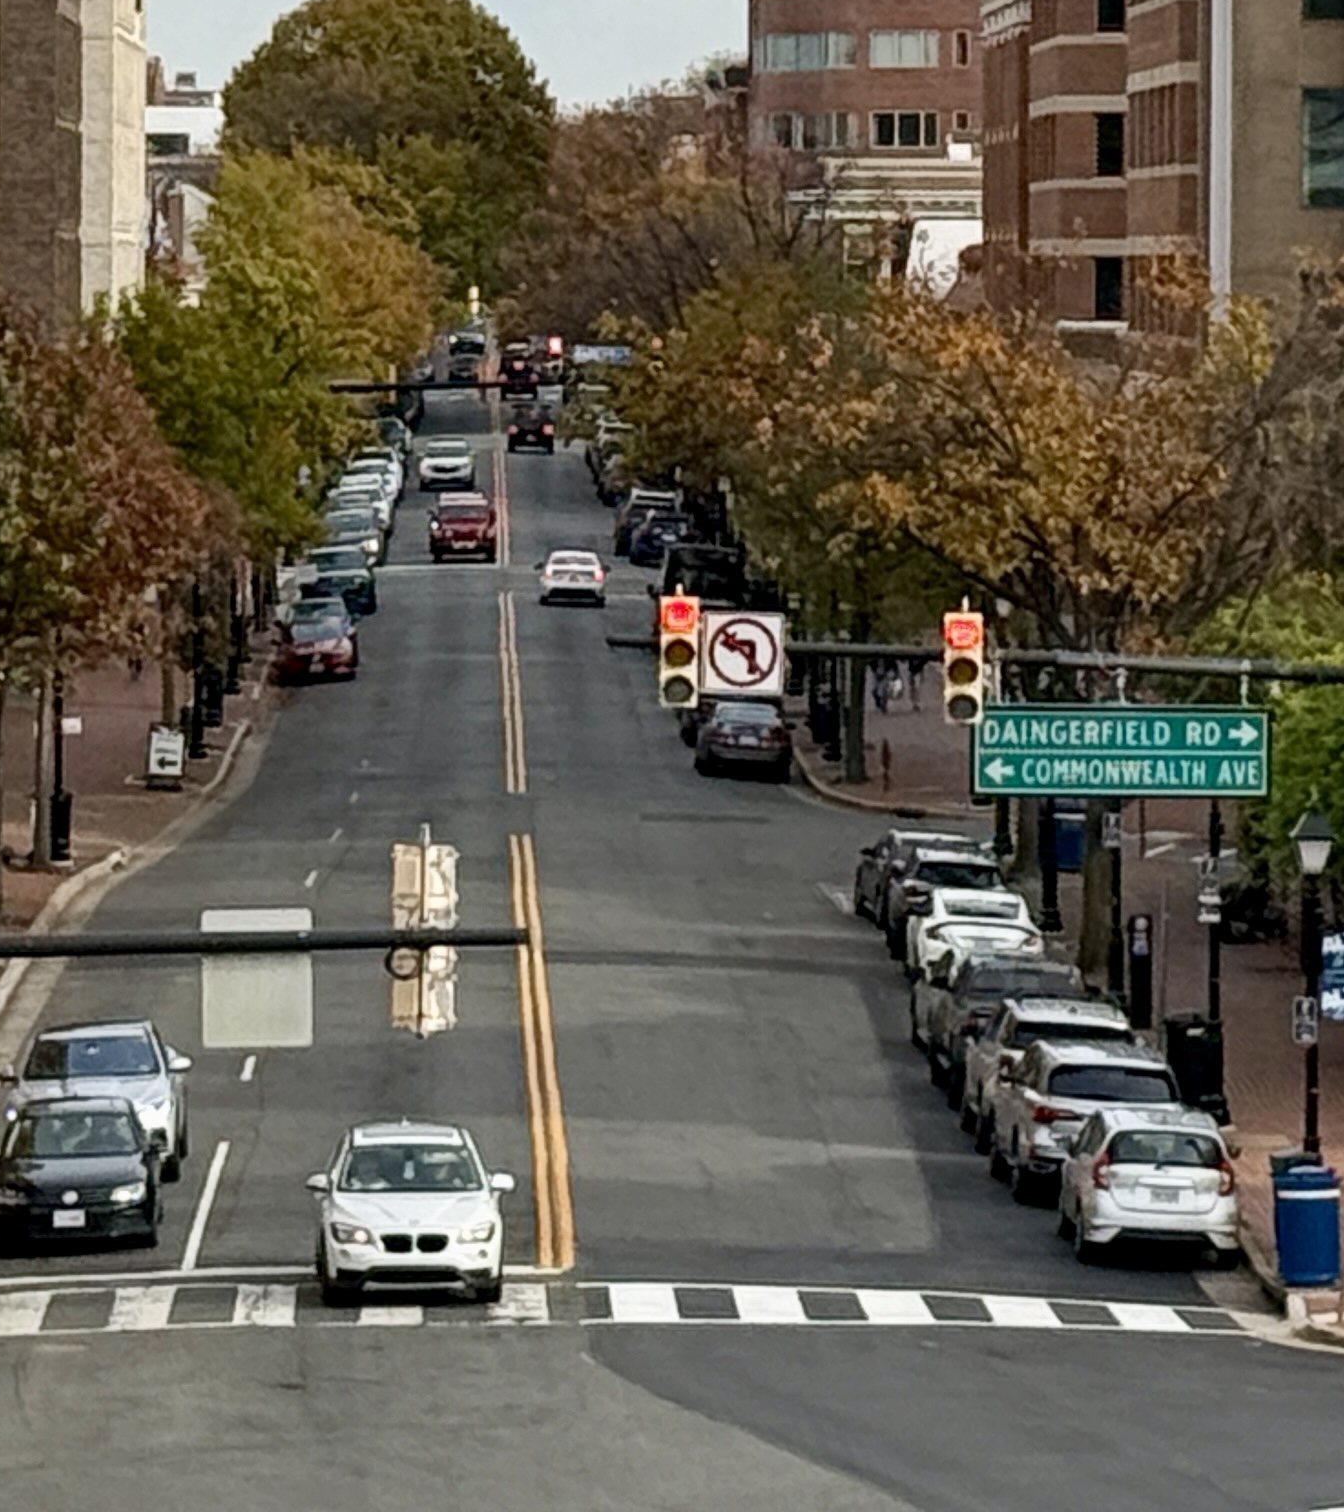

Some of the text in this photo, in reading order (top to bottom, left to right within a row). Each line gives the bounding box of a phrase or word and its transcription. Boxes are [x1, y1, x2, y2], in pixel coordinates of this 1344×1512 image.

[983, 718, 1221, 747] DAINGERFIELD RD
[1021, 757, 1260, 785] COMMONWEALTH AVE
